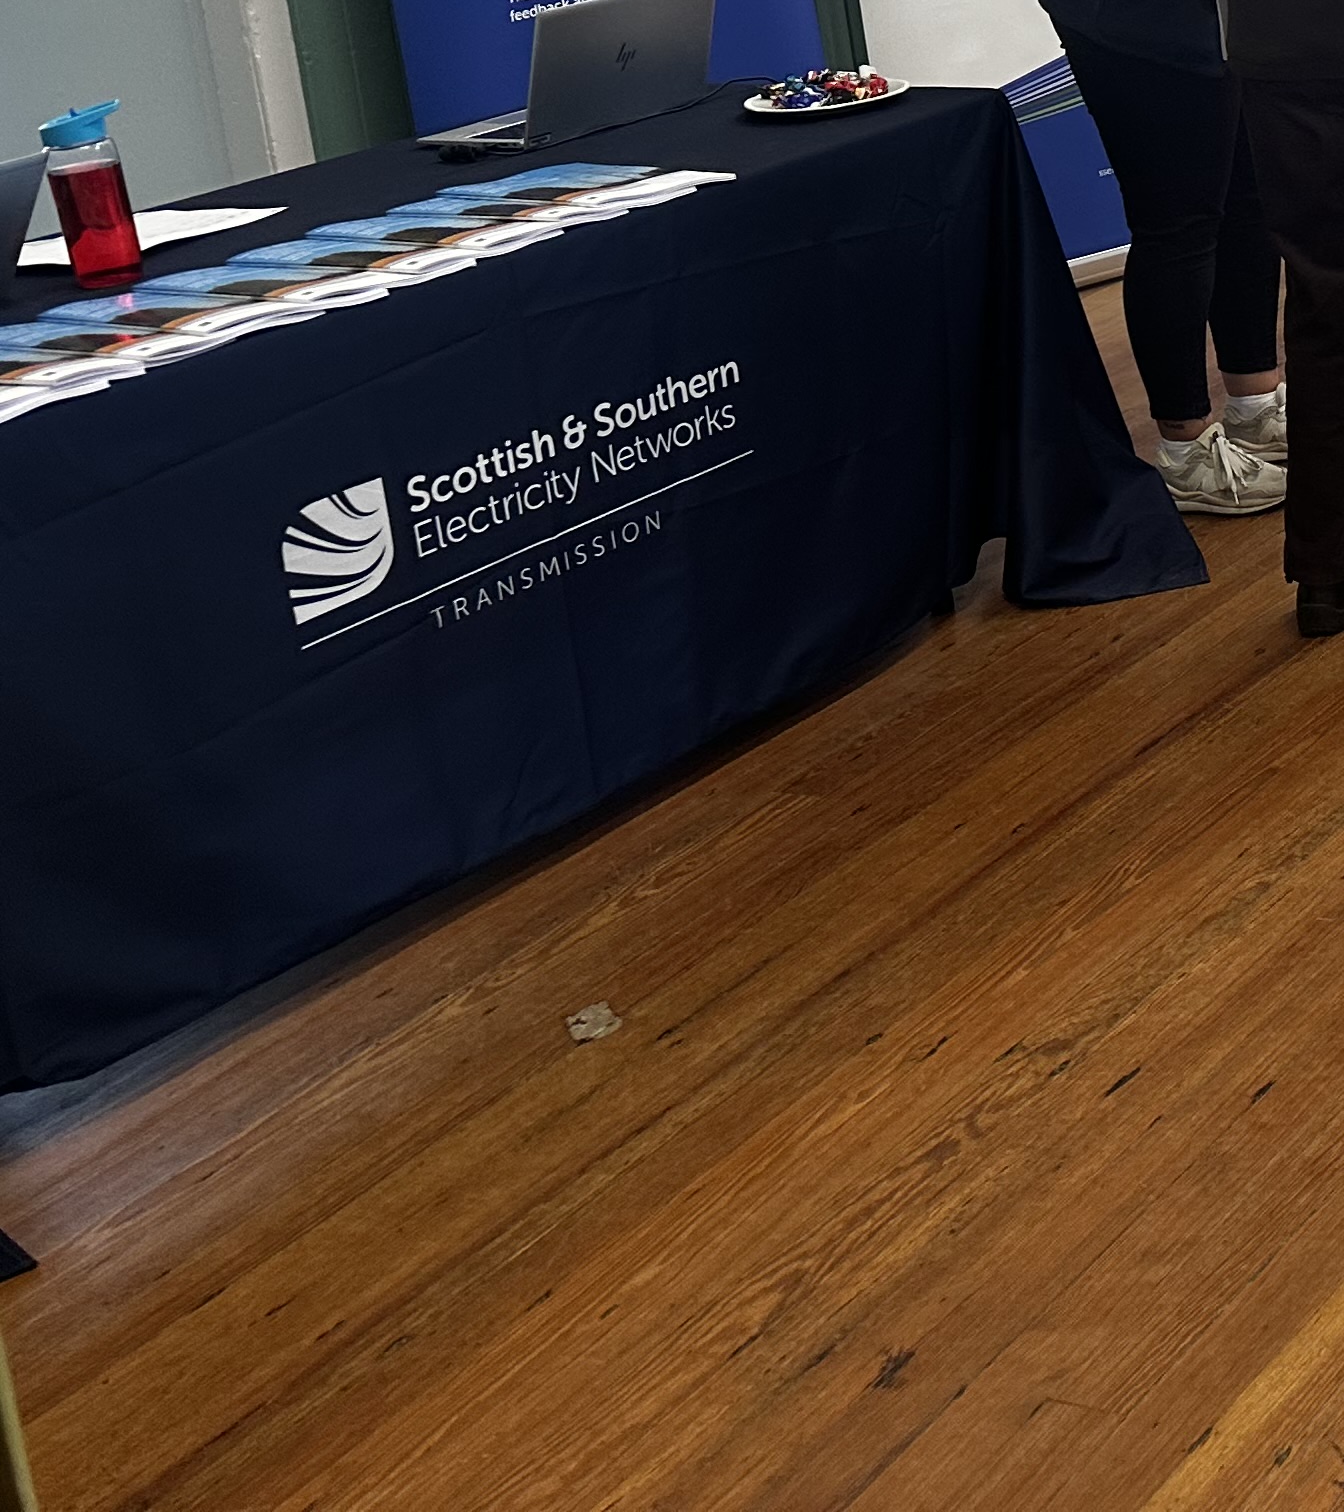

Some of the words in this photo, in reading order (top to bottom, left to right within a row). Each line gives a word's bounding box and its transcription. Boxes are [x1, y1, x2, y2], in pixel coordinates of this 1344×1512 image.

[407, 430, 555, 512] Scottish
[562, 414, 586, 449] &
[594, 361, 739, 436] Southern
[413, 466, 580, 557] Electricity
[591, 404, 735, 482] Networks
[430, 511, 660, 627] TRANSMISSION
